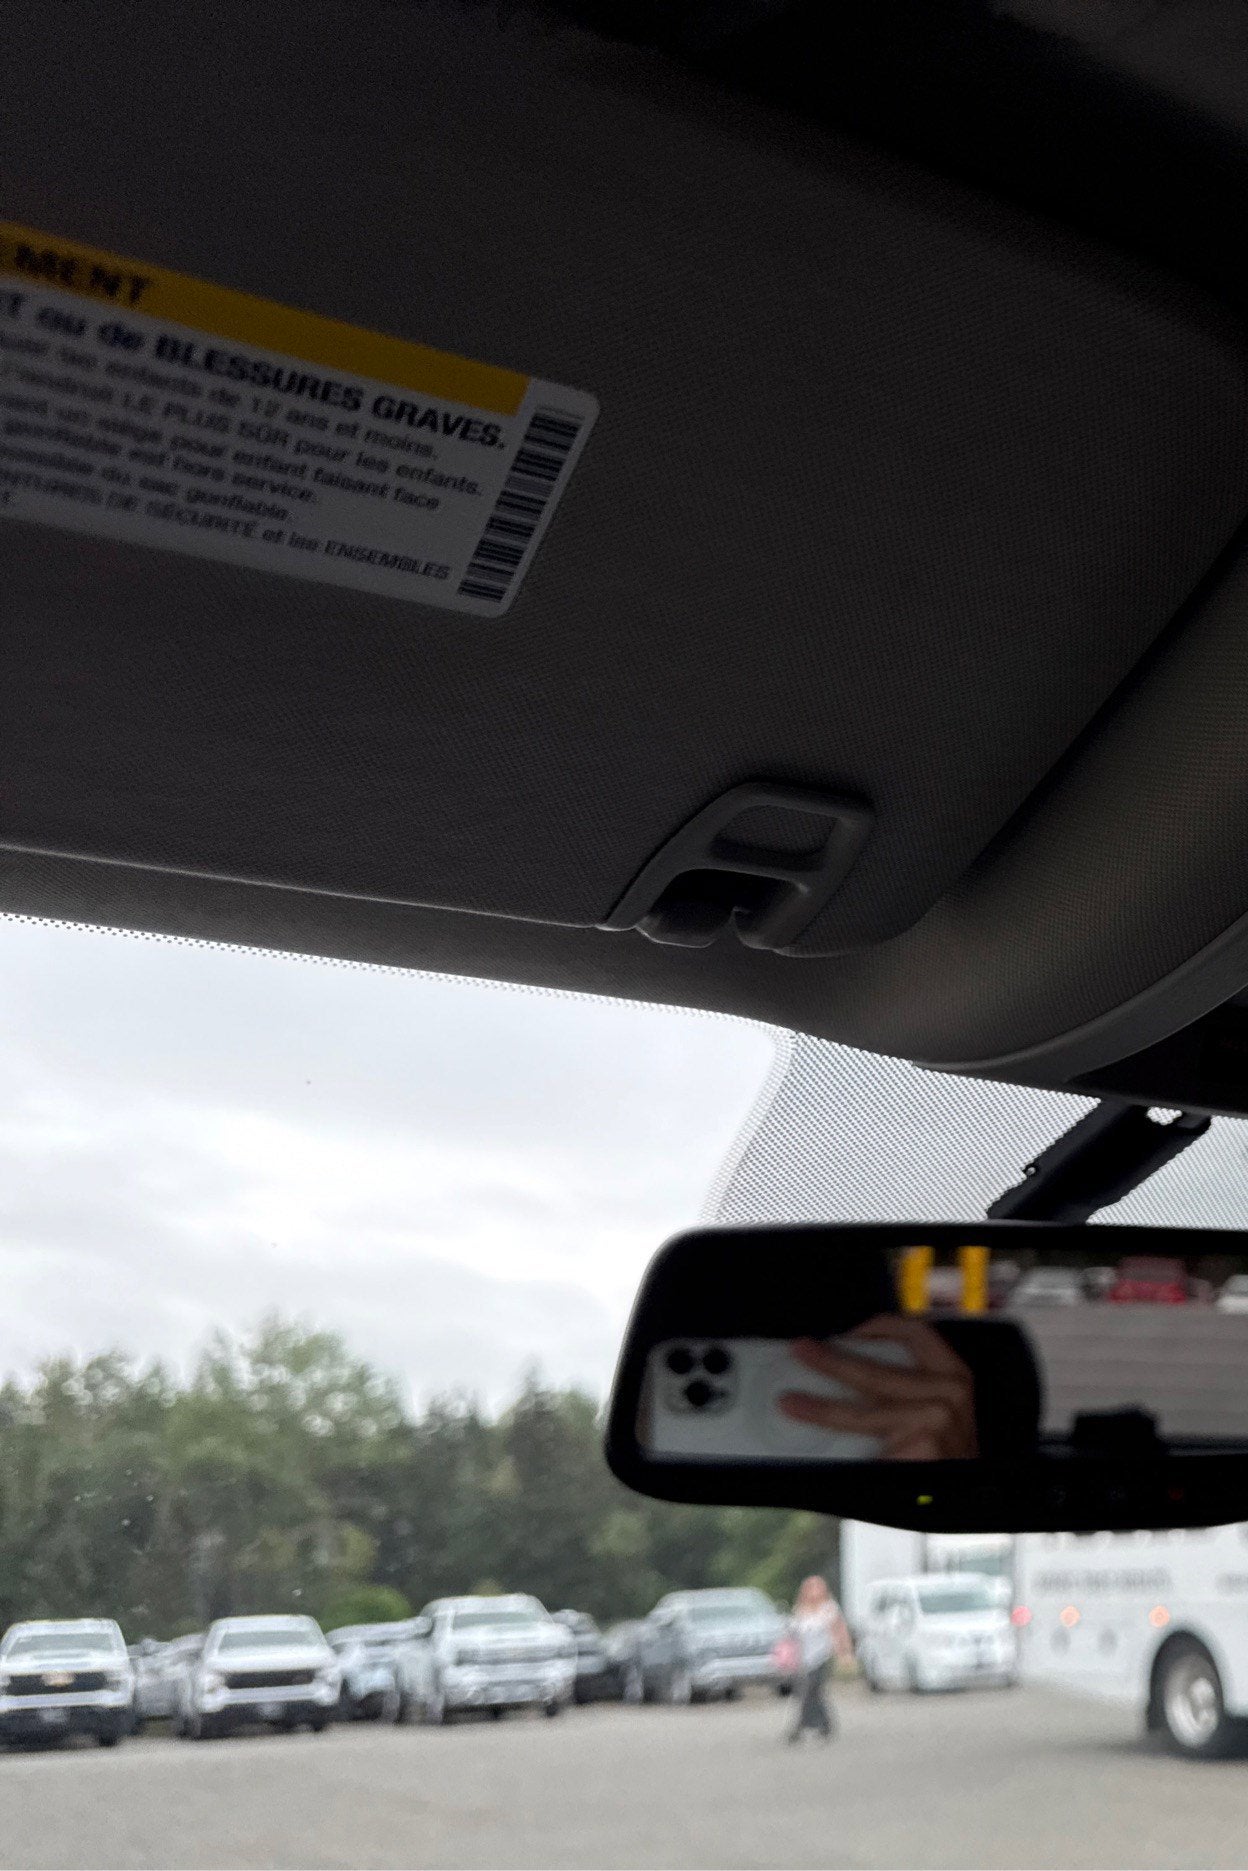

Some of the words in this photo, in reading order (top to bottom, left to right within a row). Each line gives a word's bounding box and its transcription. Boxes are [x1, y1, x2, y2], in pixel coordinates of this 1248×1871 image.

[37, 306, 86, 337] ou
[97, 321, 144, 350] de
[154, 333, 364, 413] BLESSURES
[371, 395, 505, 450] GRAVES.
[104, 361, 203, 398] enfants
[208, 387, 241, 409] de
[252, 397, 281, 419] 12
[286, 408, 329, 432] ans
[335, 420, 360, 440] et
[364, 429, 438, 461] moins.
[122, 391, 157, 415] LE
[162, 401, 231, 434] PLUS
[294, 438, 348, 464] pour
[355, 451, 390, 474] les
[396, 463, 482, 497] enfants.
[170, 435, 227, 458] pour
[232, 450, 308, 480] enfant
[313, 466, 389, 499] faisant
[394, 485, 441, 511] face
[173, 455, 226, 483] hors
[232, 471, 317, 506] service.
[325, 540, 450, 580] ENSEMBLES
